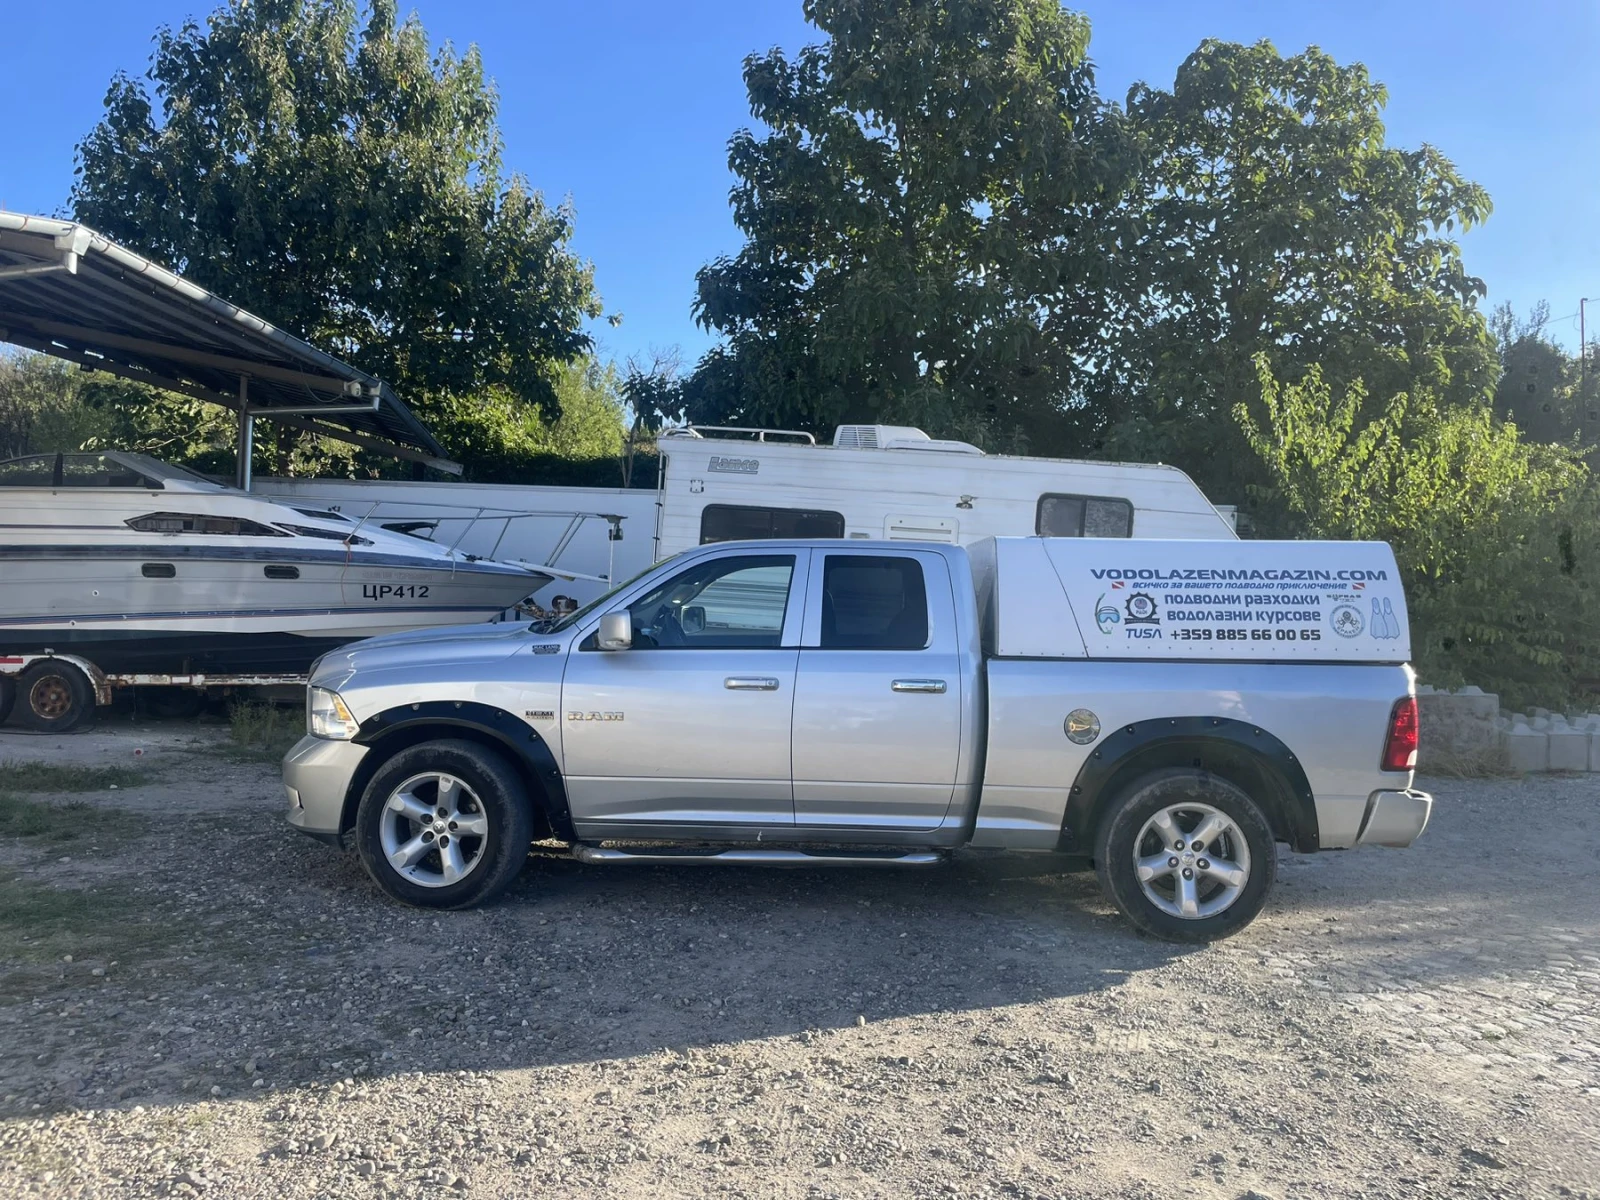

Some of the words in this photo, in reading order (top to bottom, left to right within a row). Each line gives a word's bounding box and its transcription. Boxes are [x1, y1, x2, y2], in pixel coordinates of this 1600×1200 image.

[1090, 569, 1388, 581] VODOLAZENMAGAZIN.COM
[363, 584, 430, 601] ЦР412
[1170, 629, 1213, 640] +359
[1216, 629, 1248, 640] 885
[1251, 629, 1272, 641] 66
[1275, 629, 1297, 641] 00
[1300, 629, 1321, 641] 65
[567, 711, 625, 721] RAM
